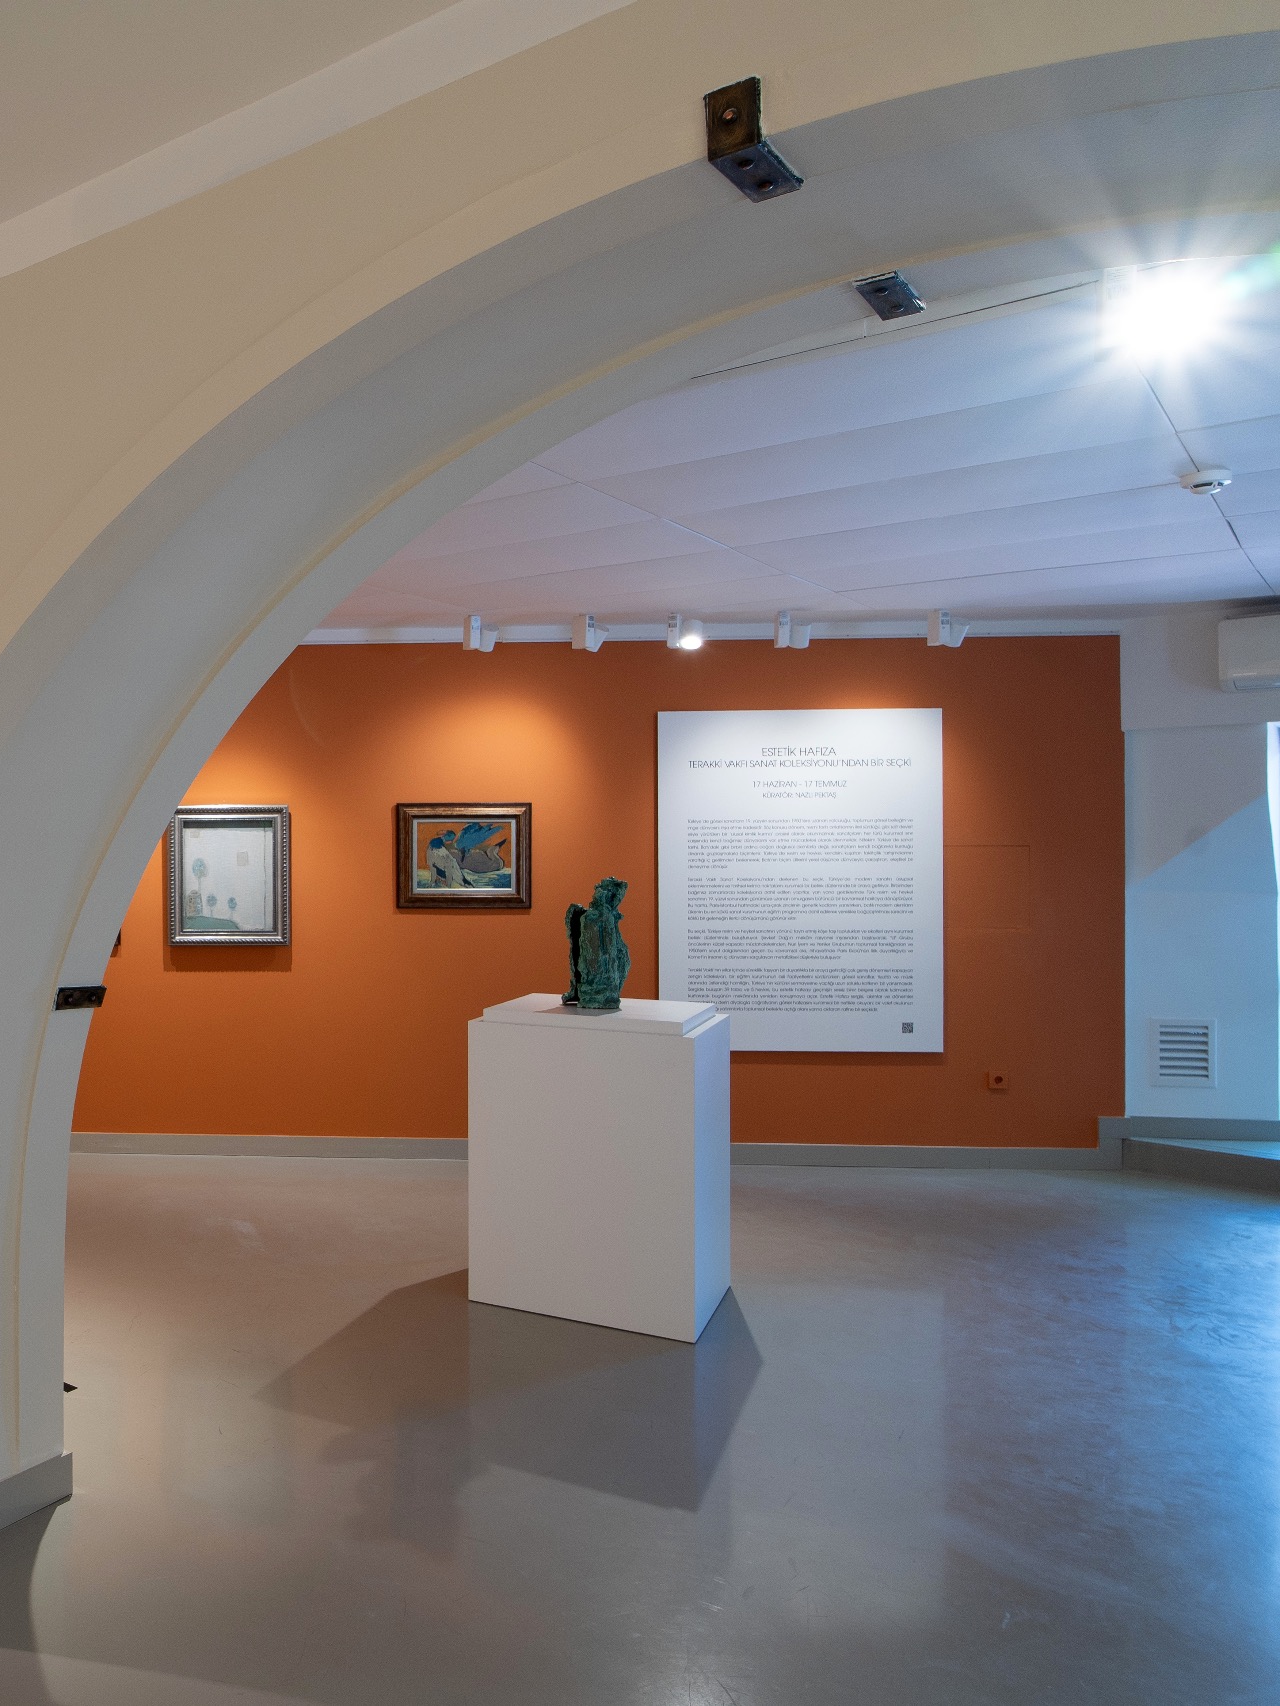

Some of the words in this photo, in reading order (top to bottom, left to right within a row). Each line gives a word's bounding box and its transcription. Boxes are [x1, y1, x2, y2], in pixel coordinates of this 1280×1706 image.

[761, 745, 797, 757] ESTETİK
[799, 747, 837, 756] HAFIZA
[688, 758, 722, 768] TERAKKİ
[724, 759, 748, 768] VAKFI
[749, 759, 777, 768] SANAT
[870, 757, 884, 767] BİR
[886, 757, 912, 769] SEÇKİ
[752, 780, 761, 788] 17
[763, 779, 797, 788] HAZİRAN
[805, 780, 813, 788] 17
[815, 780, 847, 788] TEMMUZ
